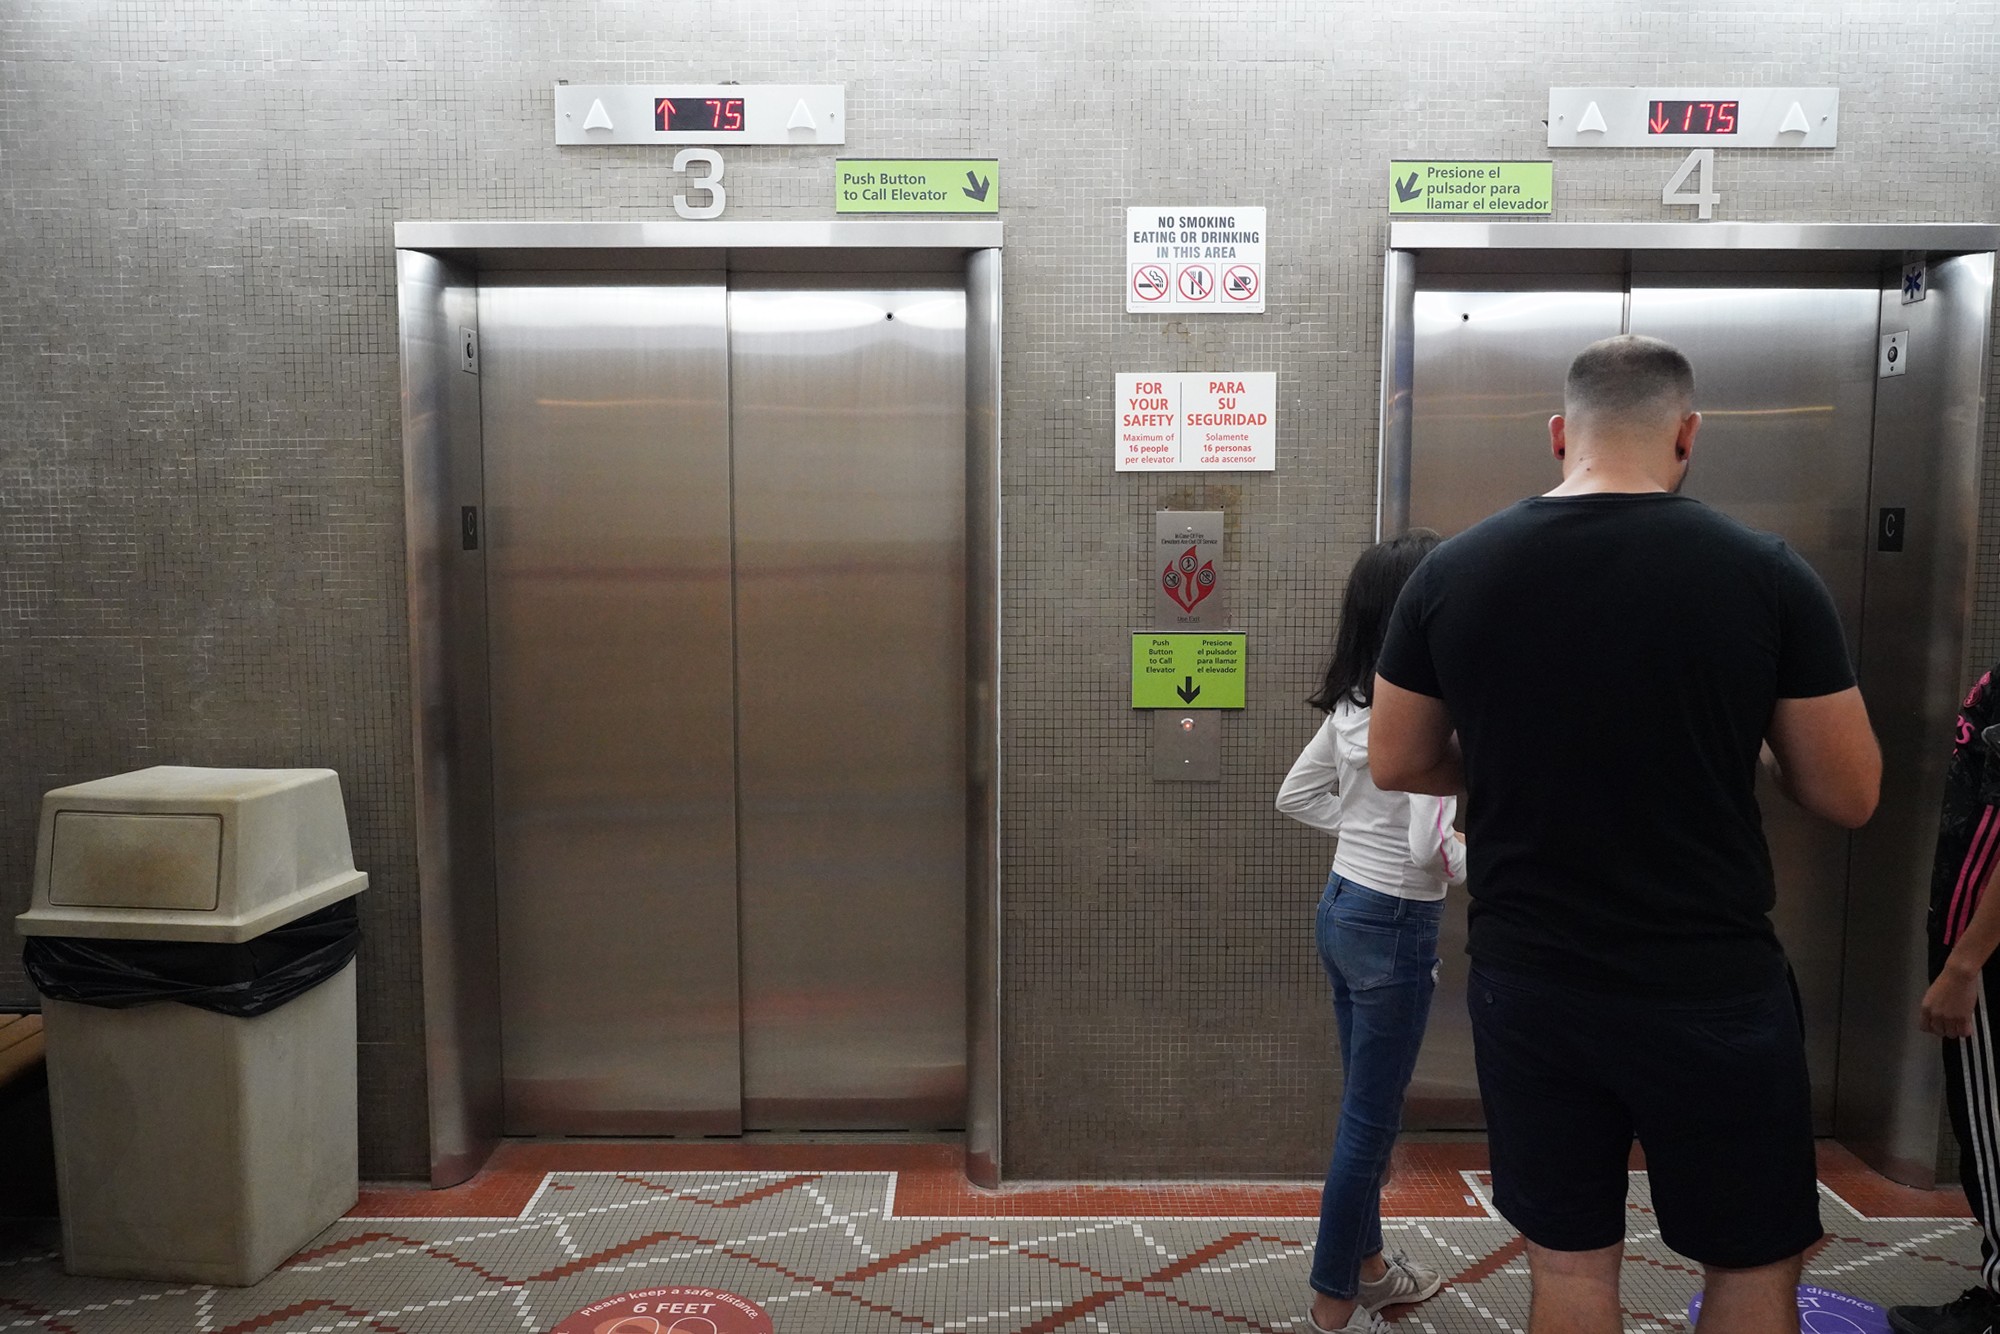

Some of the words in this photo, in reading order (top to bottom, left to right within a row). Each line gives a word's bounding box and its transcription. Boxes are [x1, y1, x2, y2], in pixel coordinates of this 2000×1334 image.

[705, 100, 743, 130] 75
[1681, 103, 1737, 133] 175
[843, 172, 875, 185] Push
[880, 173, 926, 185] Button
[1427, 166, 1485, 179] Presione
[1488, 166, 1501, 179] el
[672, 148, 726, 220] 3
[1427, 182, 1486, 196] pulsador
[1490, 184, 1521, 197] para
[1662, 148, 1720, 219] 4
[843, 189, 858, 201] to
[862, 188, 887, 201] Call
[891, 188, 948, 201] Elevator
[1427, 197, 1469, 209] llamar
[1473, 197, 1485, 209] el
[1489, 197, 1549, 210] elevador
[1158, 216, 1175, 228] NO
[1179, 216, 1235, 228] SMOKING
[1133, 231, 1176, 243] EATING
[1180, 231, 1197, 243] OR
[1201, 231, 1259, 244] DRINKING
[1156, 246, 1169, 258] IN
[1173, 246, 1200, 258] THIS
[1204, 246, 1236, 258] AREA
[1135, 382, 1163, 395] FOR
[1209, 381, 1246, 394] PARA
[1129, 398, 1169, 411] YOUR
[1218, 397, 1236, 410] SU
[1123, 414, 1174, 427] SAFETY
[1187, 413, 1268, 426] SEGURIDAD
[1123, 433, 1163, 441] Maximum
[1164, 433, 1175, 441] of
[1206, 433, 1249, 441] Solamente
[1129, 444, 1138, 452] 16
[1140, 444, 1169, 455] people
[1203, 444, 1213, 452] 16
[1215, 444, 1252, 454] personas
[1125, 457, 1139, 465] per
[1141, 455, 1175, 463] elevator
[1200, 455, 1219, 463] cada
[1196, 658, 1213, 666] para
[580, 1295, 626, 1317] Please
[628, 1287, 666, 1299] keep
[684, 1287, 714, 1298] safe
[716, 1292, 759, 1320] distance.
[1806, 1286, 1875, 1313] distance.
[632, 1302, 649, 1314] 6
[655, 1302, 716, 1314] FEET
